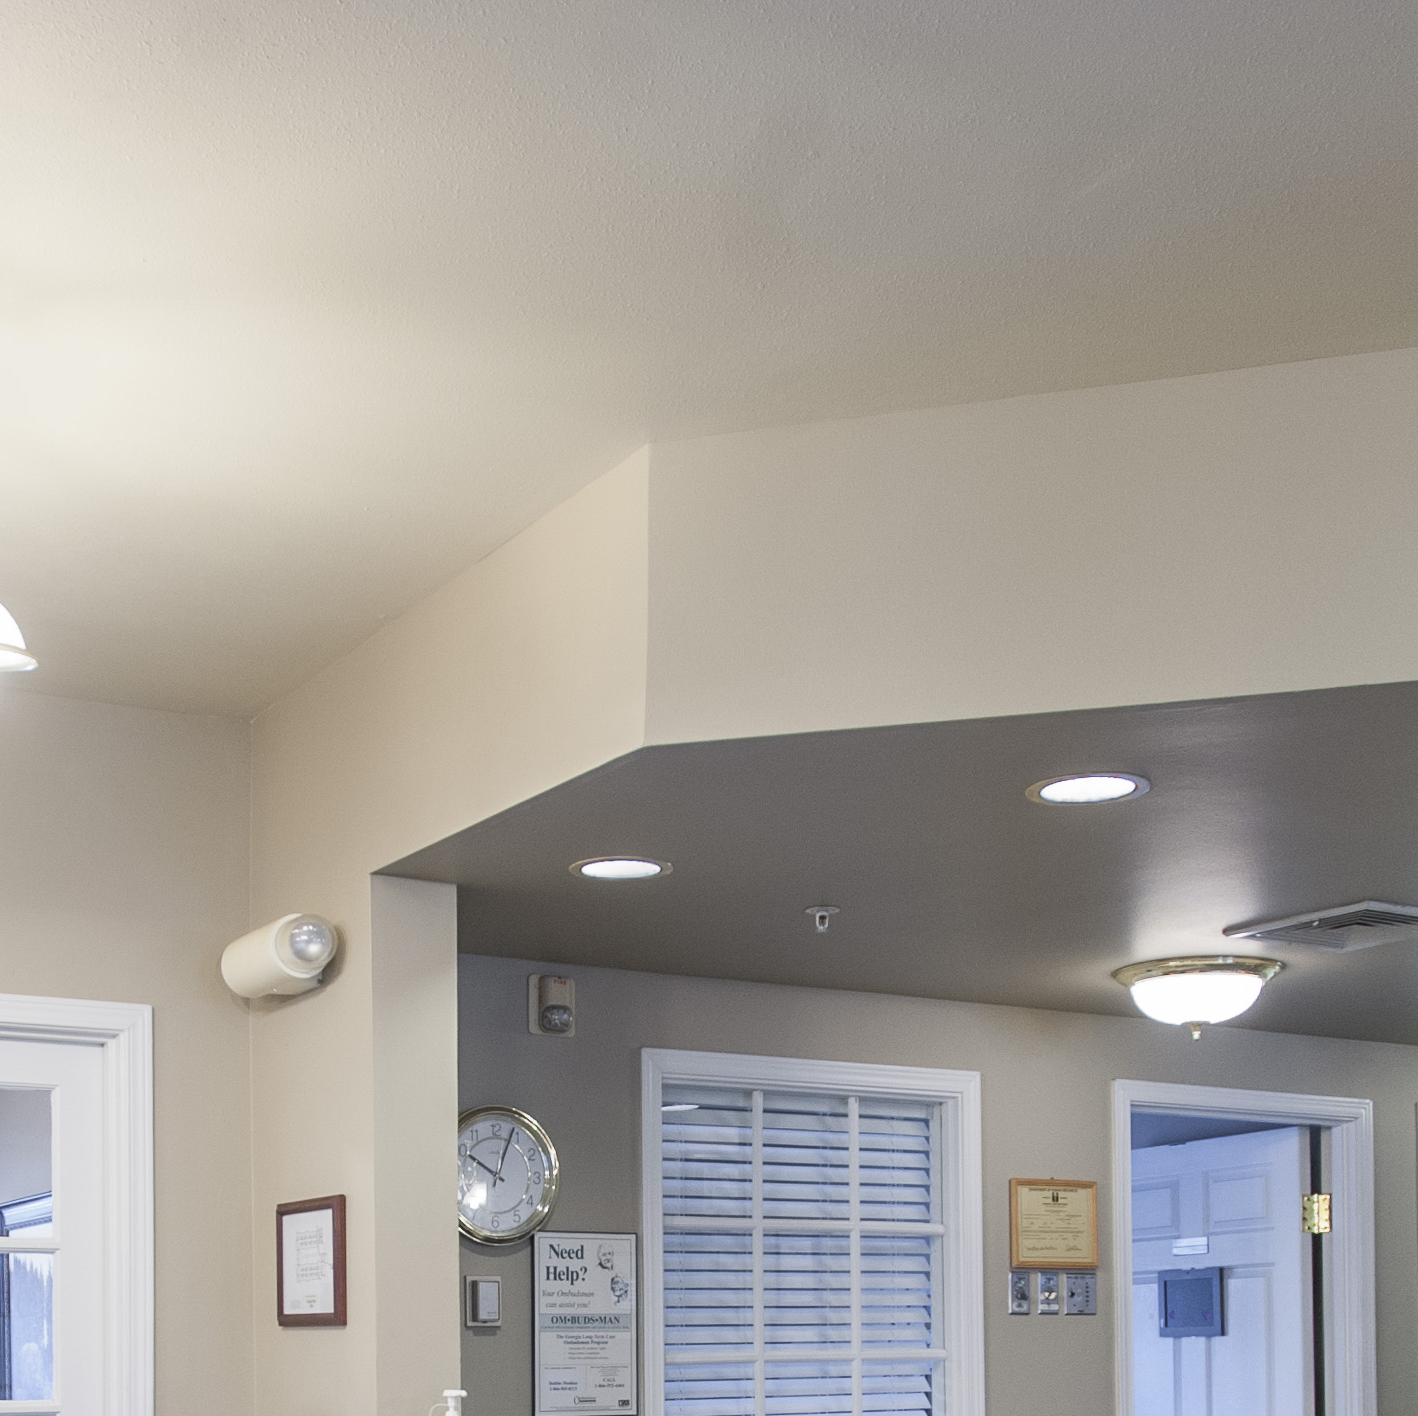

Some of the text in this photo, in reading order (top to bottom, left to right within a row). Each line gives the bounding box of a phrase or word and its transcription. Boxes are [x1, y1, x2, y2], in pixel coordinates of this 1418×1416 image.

[470, 1128, 479, 1141] 11
[490, 1122, 502, 1136] 12
[527, 1147, 536, 1161] 2
[533, 1171, 541, 1185] 3
[526, 1195, 534, 1207] 4
[491, 1215, 500, 1229] 6
[513, 1209, 521, 1223] 5
[548, 1243, 585, 1260] Need
[545, 1265, 588, 1286] Help?
